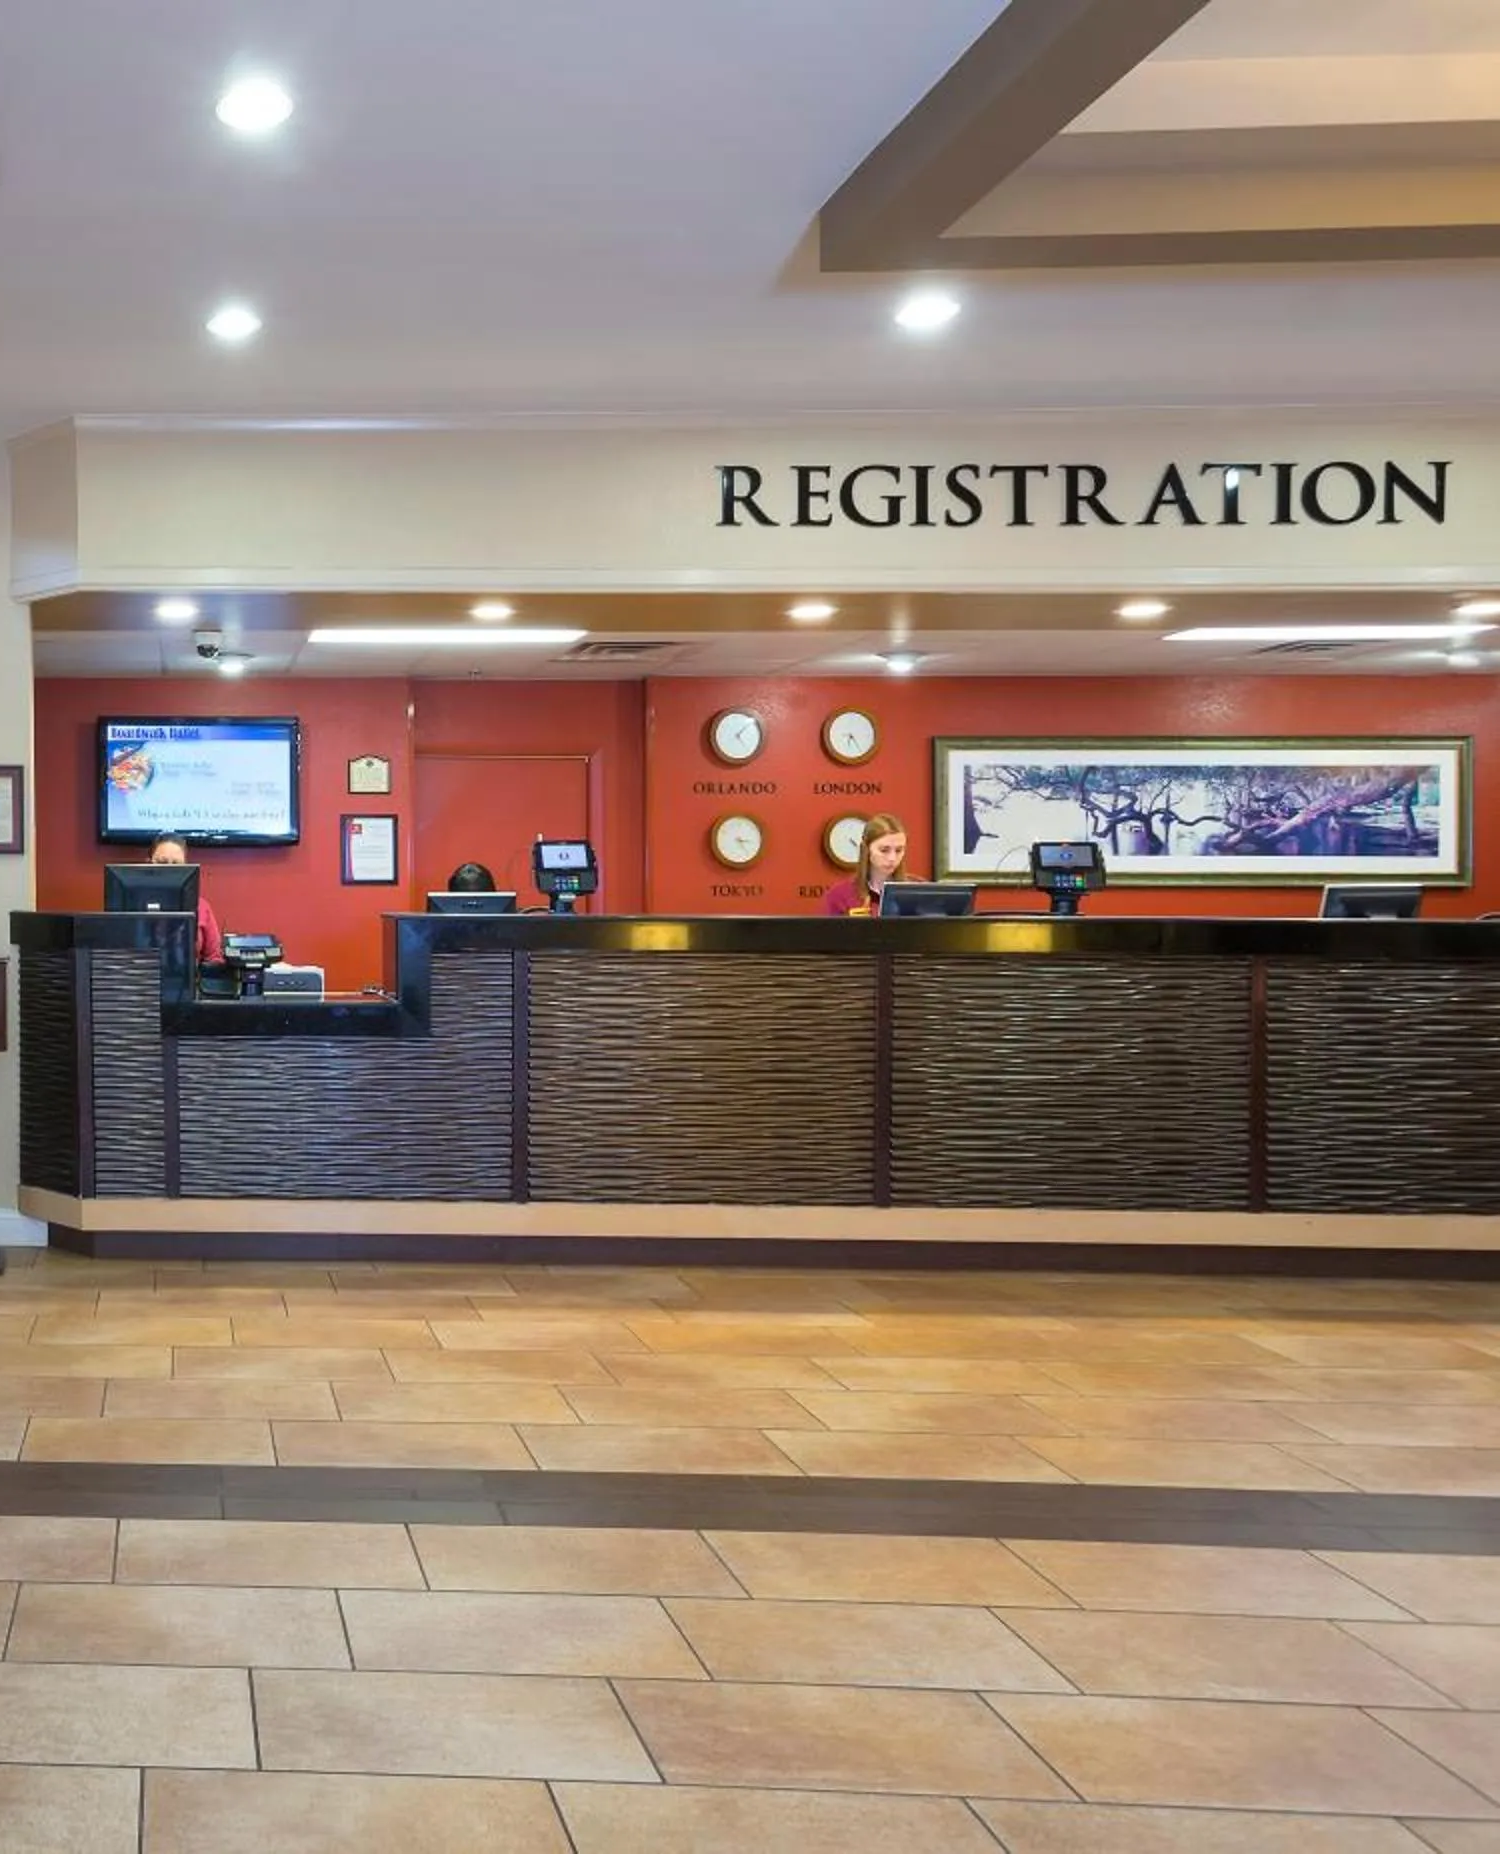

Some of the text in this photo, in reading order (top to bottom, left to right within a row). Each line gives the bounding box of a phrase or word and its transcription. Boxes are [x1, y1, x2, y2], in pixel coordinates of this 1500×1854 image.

[714, 460, 1453, 529] REGISTRATION
[693, 782, 777, 795] ORLANDO
[813, 782, 882, 795] LONDON
[710, 885, 764, 897] TOKYO
[799, 885, 824, 897] RIO
